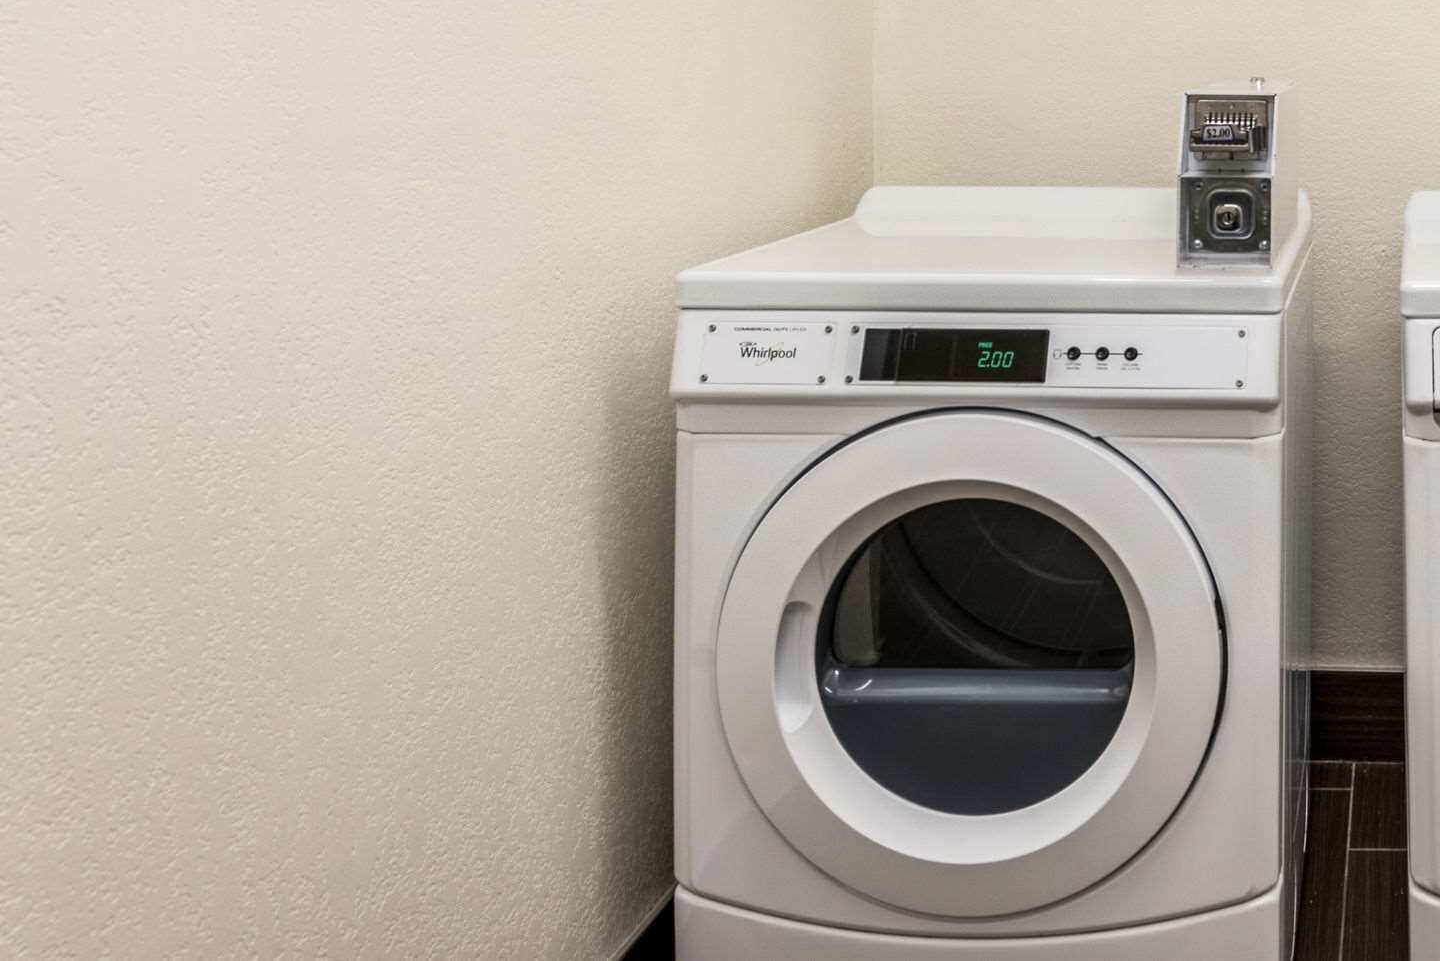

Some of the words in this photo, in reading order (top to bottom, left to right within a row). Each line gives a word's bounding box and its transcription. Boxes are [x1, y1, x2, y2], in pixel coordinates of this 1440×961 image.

[1206, 127, 1231, 138] $2.00
[740, 346, 797, 361] Whirlpool
[977, 351, 1015, 368] 2.00
